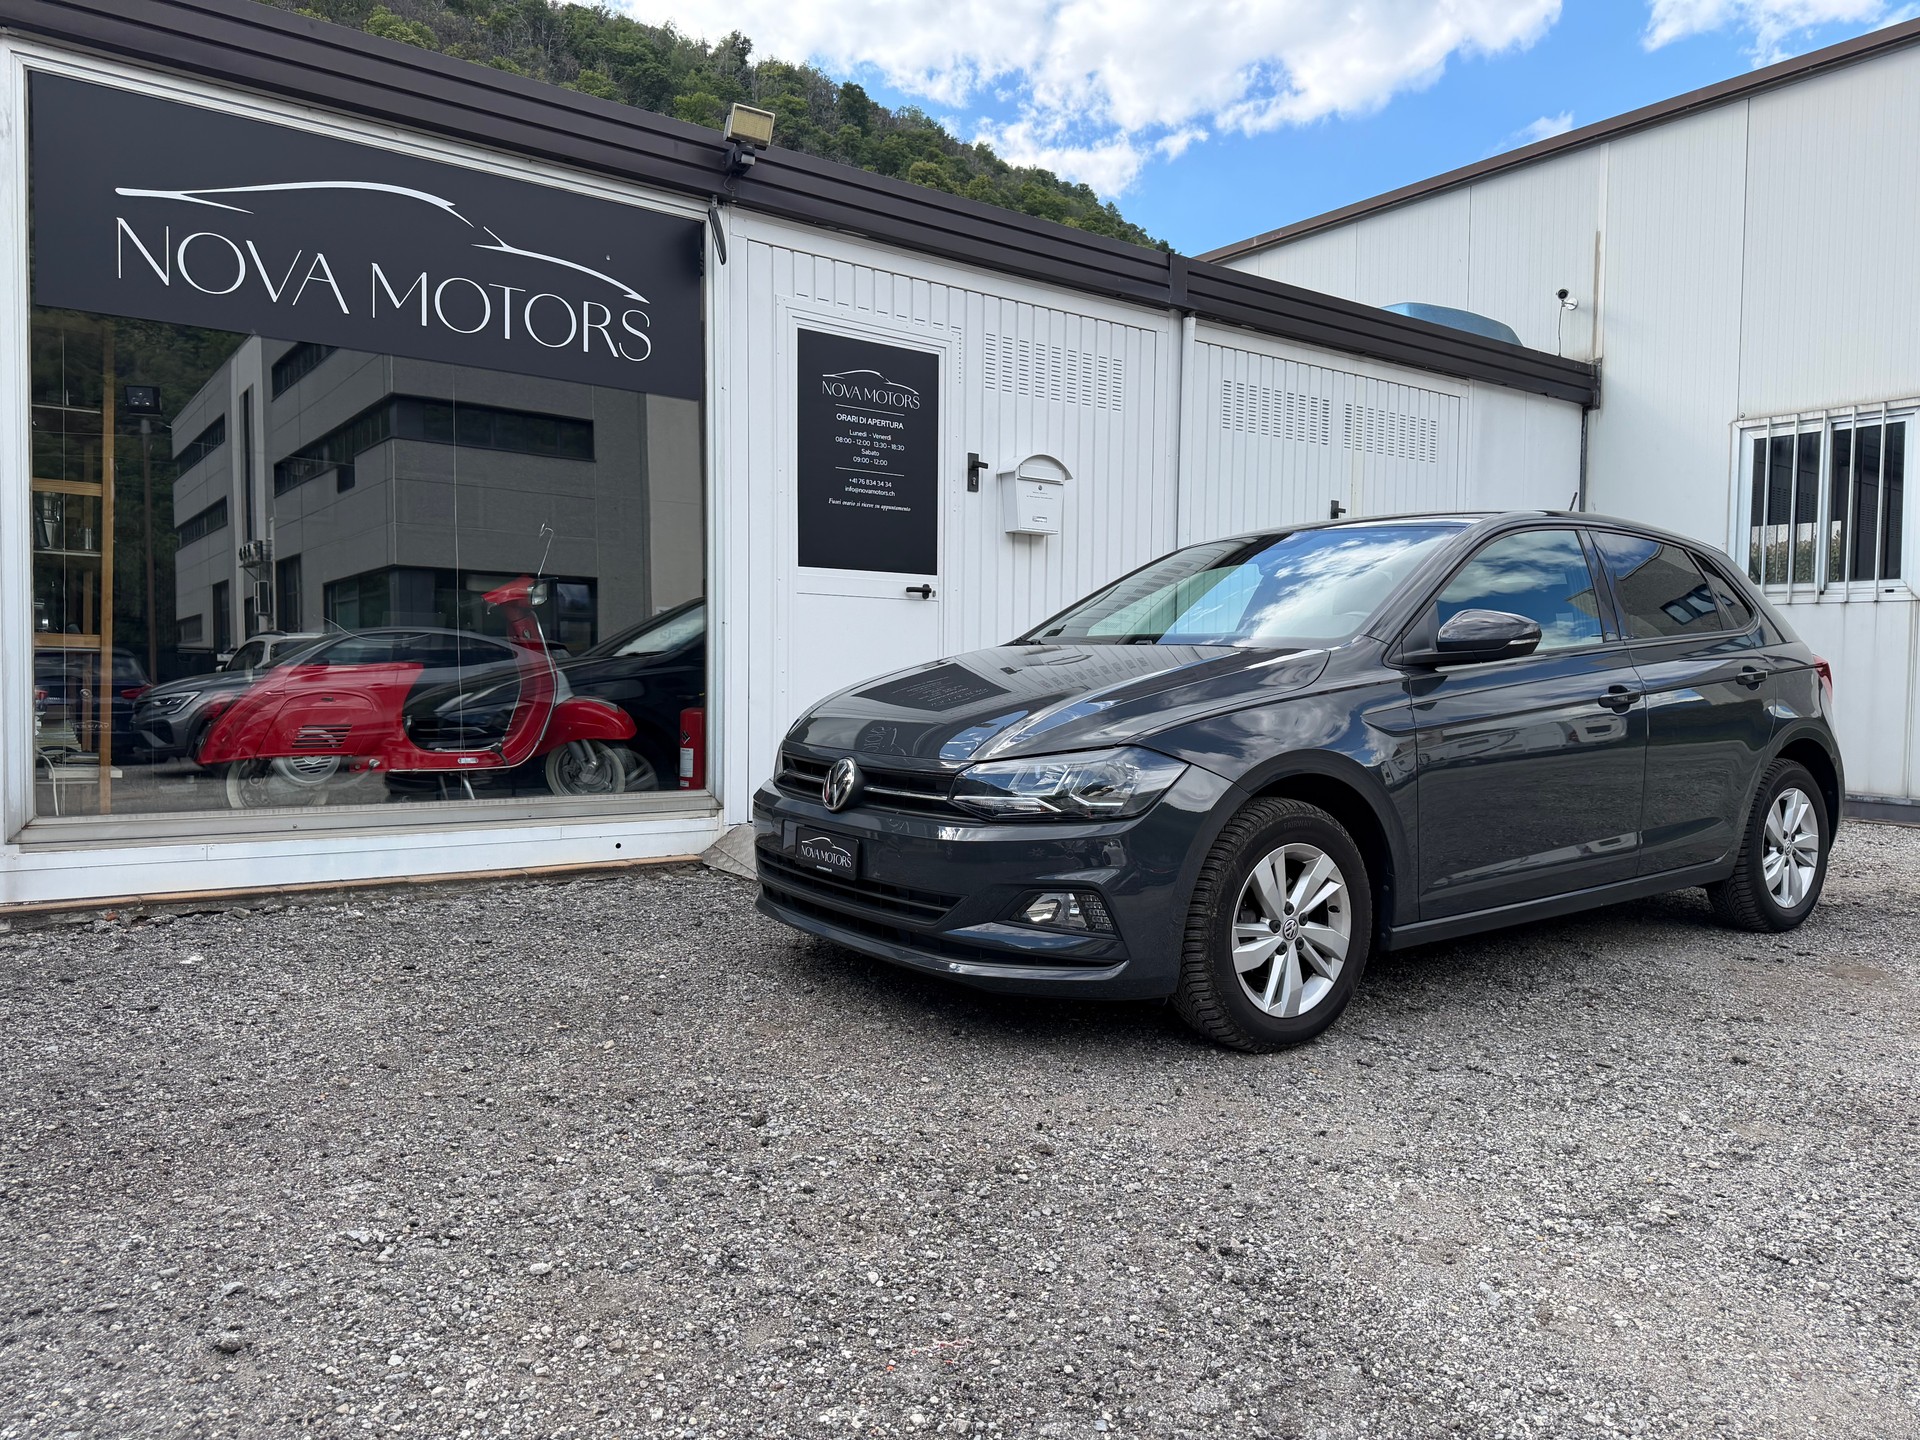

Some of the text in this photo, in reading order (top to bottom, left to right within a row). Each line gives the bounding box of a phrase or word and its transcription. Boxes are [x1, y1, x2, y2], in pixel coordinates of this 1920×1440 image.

[116, 216, 653, 362] NOVA MOTORS
[822, 380, 920, 410] NOVA MOTORS
[836, 413, 904, 429] ORARI DI APERTURA
[835, 436, 852, 444] 08:00
[873, 441, 887, 449] 13:30
[891, 443, 905, 451] 18:30
[861, 448, 880, 457] Sabato
[852, 456, 870, 464] 09:00
[873, 458, 888, 466] 12:00
[844, 485, 896, 497] info@novamotors.ch
[828, 497, 842, 505] Fuori
[880, 504, 911, 512] appuntamento
[1283, 819, 1313, 831] FAIRWAY
[801, 845, 852, 868] NOVA MOTORS
